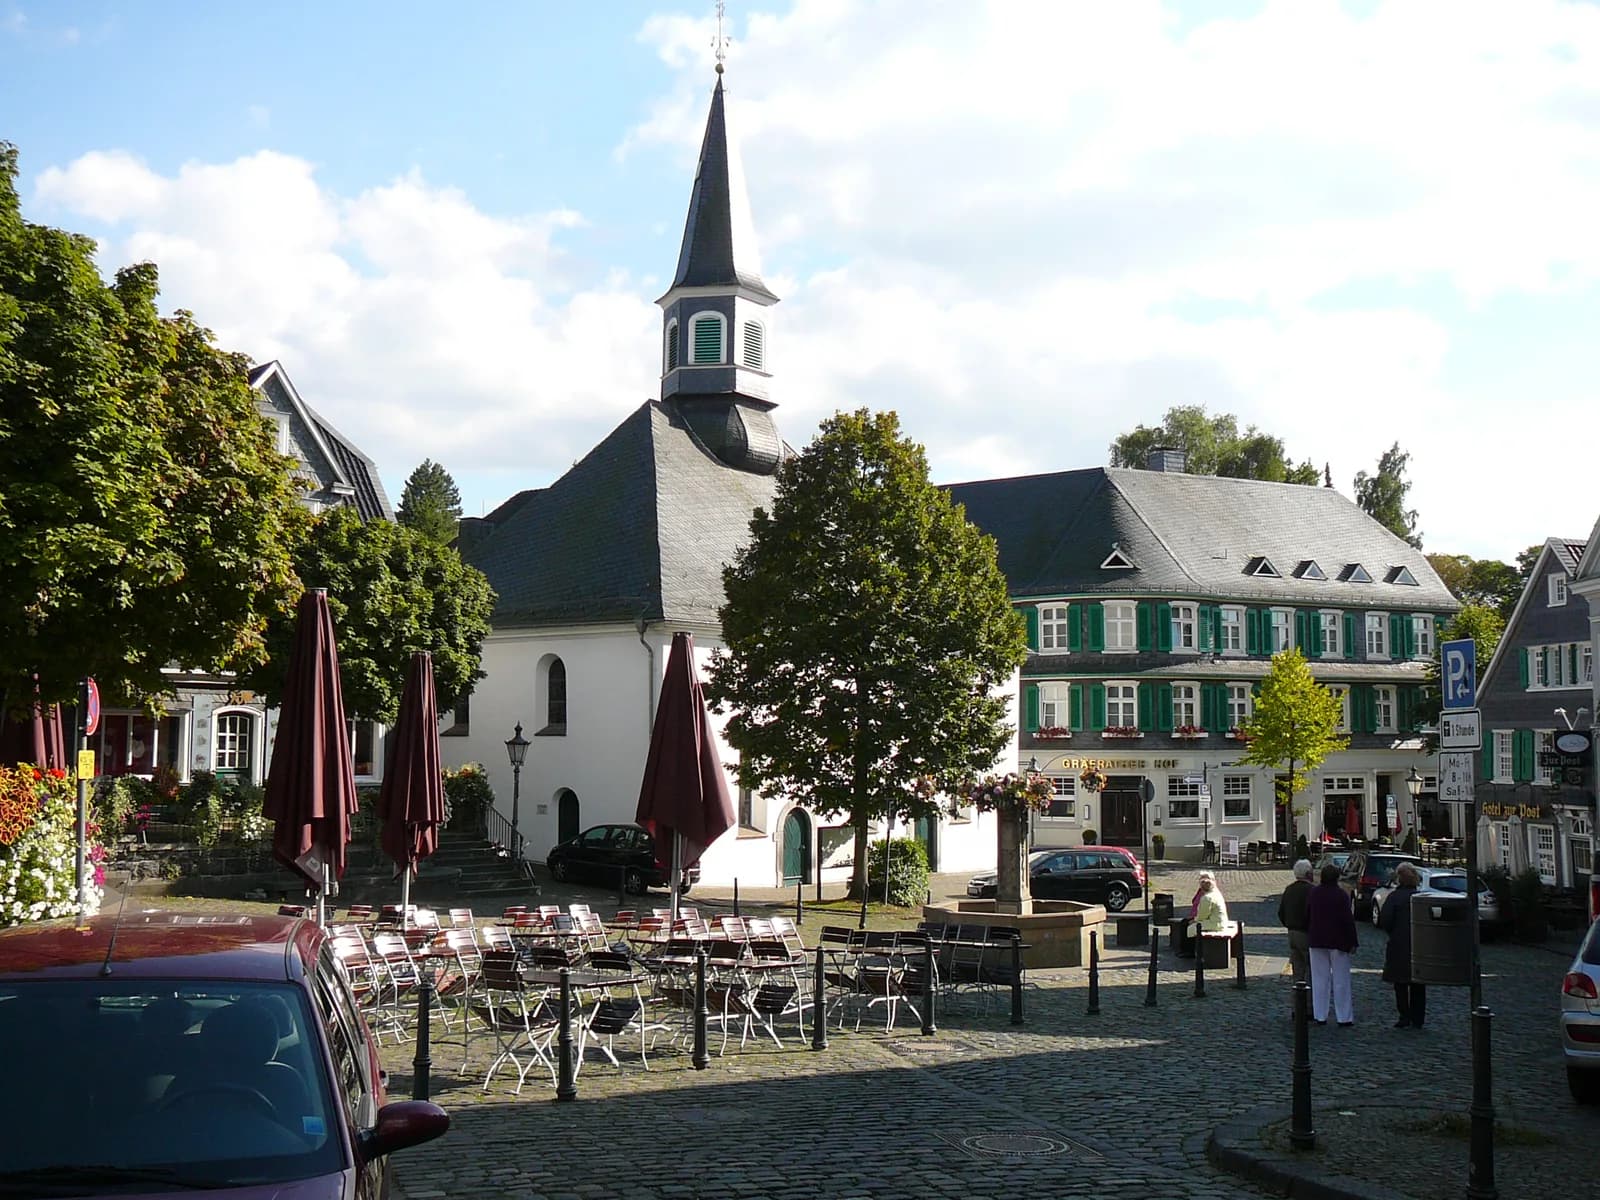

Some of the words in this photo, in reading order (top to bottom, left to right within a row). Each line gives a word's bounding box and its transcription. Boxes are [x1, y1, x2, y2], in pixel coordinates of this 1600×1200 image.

[1447, 650, 1465, 700] P
[1154, 760, 1179, 769] HOF
[1519, 803, 1540, 818] Post
